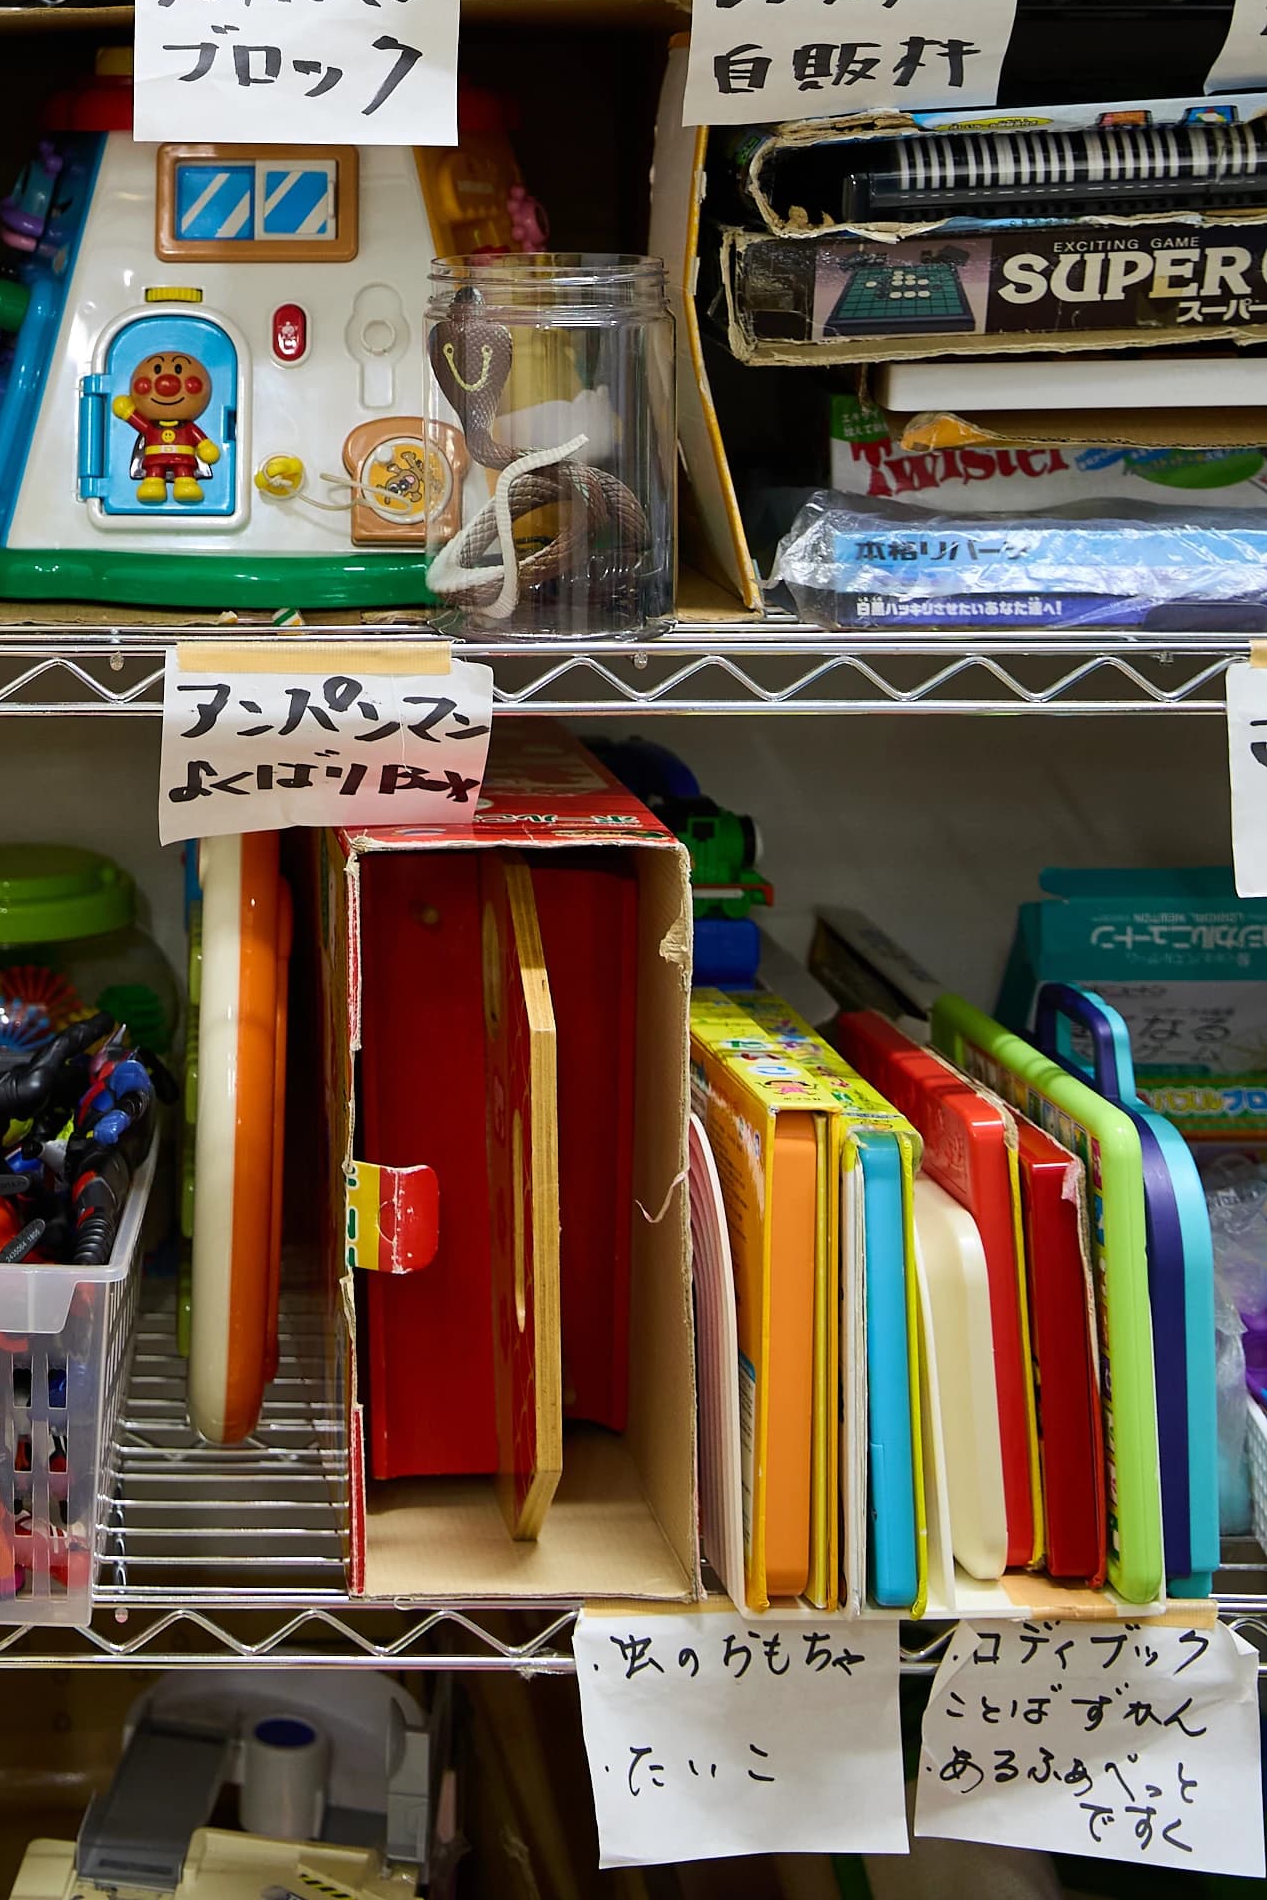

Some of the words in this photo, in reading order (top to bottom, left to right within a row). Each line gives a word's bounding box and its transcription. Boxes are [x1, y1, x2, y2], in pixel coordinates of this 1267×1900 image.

[161, 23, 424, 116] ブロック
[1053, 238, 1140, 254] EXCITING
[1150, 235, 1201, 249] GAME
[997, 246, 1254, 304] SUPER
[856, 600, 1062, 617] 白黒ハッキリさせたいあなた達へ!
[176, 675, 492, 743] アンパンマン
[944, 1680, 1208, 1738] ことばずかん
[1080, 1801, 1193, 1854] ですく
